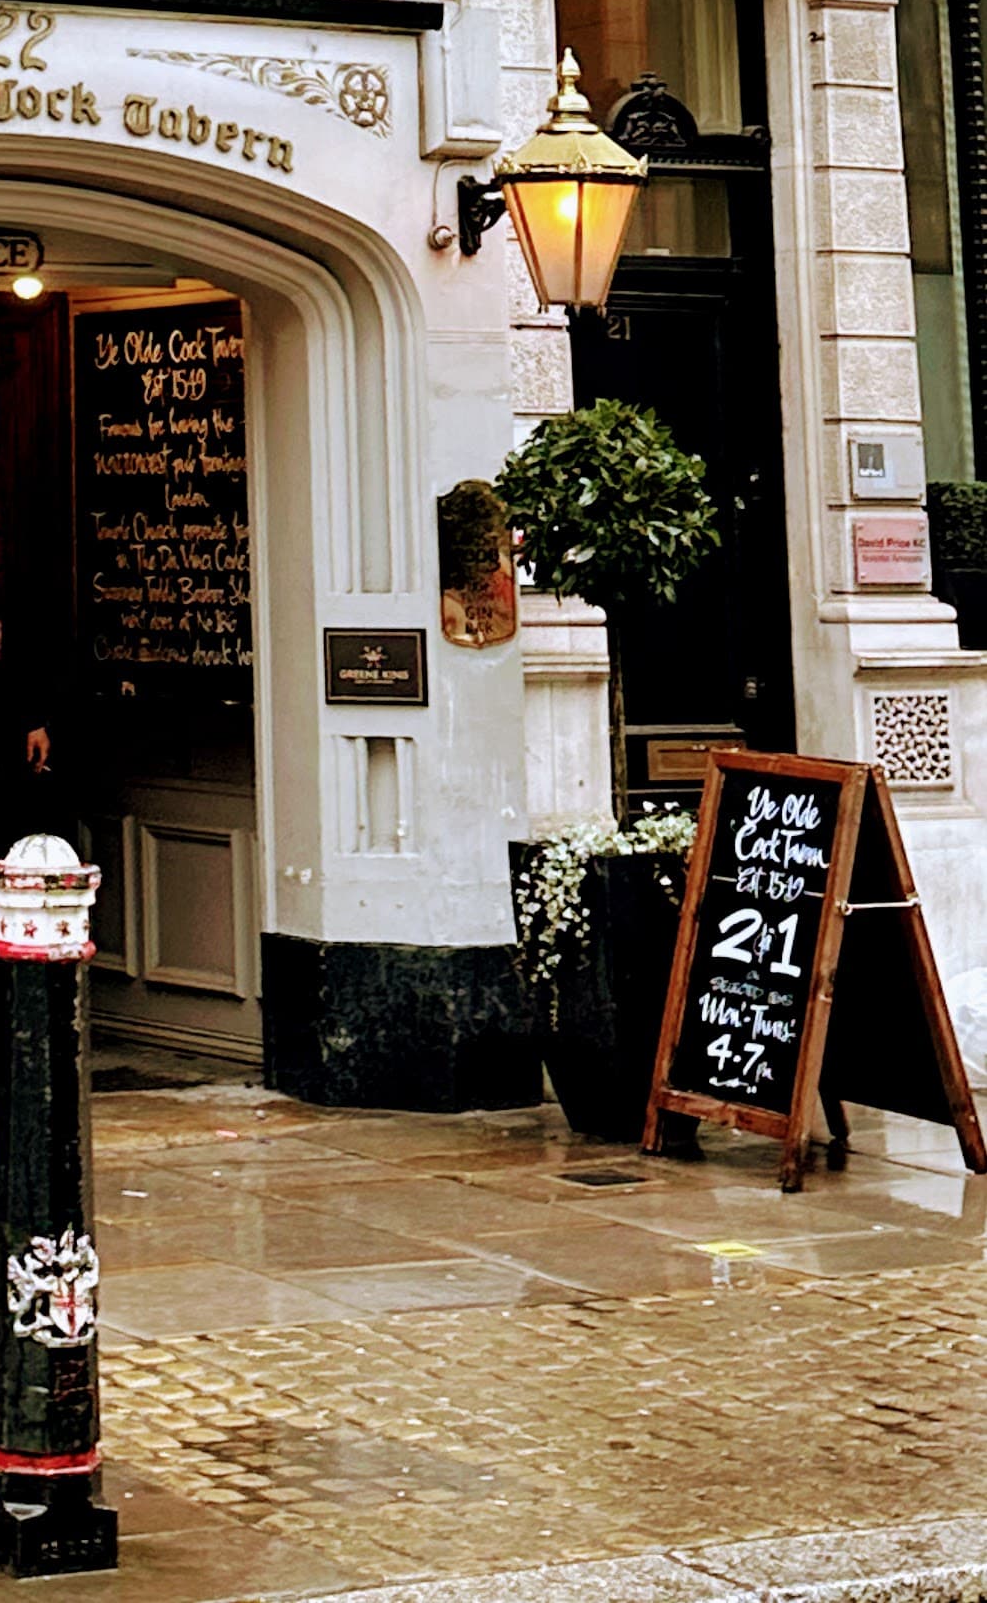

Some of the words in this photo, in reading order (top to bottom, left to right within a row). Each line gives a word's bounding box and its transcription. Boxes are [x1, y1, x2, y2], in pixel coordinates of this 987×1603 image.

[122, 93, 294, 174] Tavern
[607, 315, 631, 340] 21
[95, 333, 120, 370] Ye
[124, 330, 164, 365] Olde
[169, 329, 207, 363] Cock
[173, 368, 207, 401] 1549
[744, 785, 780, 823] Ye
[782, 793, 822, 829] Olde
[734, 823, 781, 863] Cock
[711, 907, 763, 964] 2
[770, 913, 802, 978] 1
